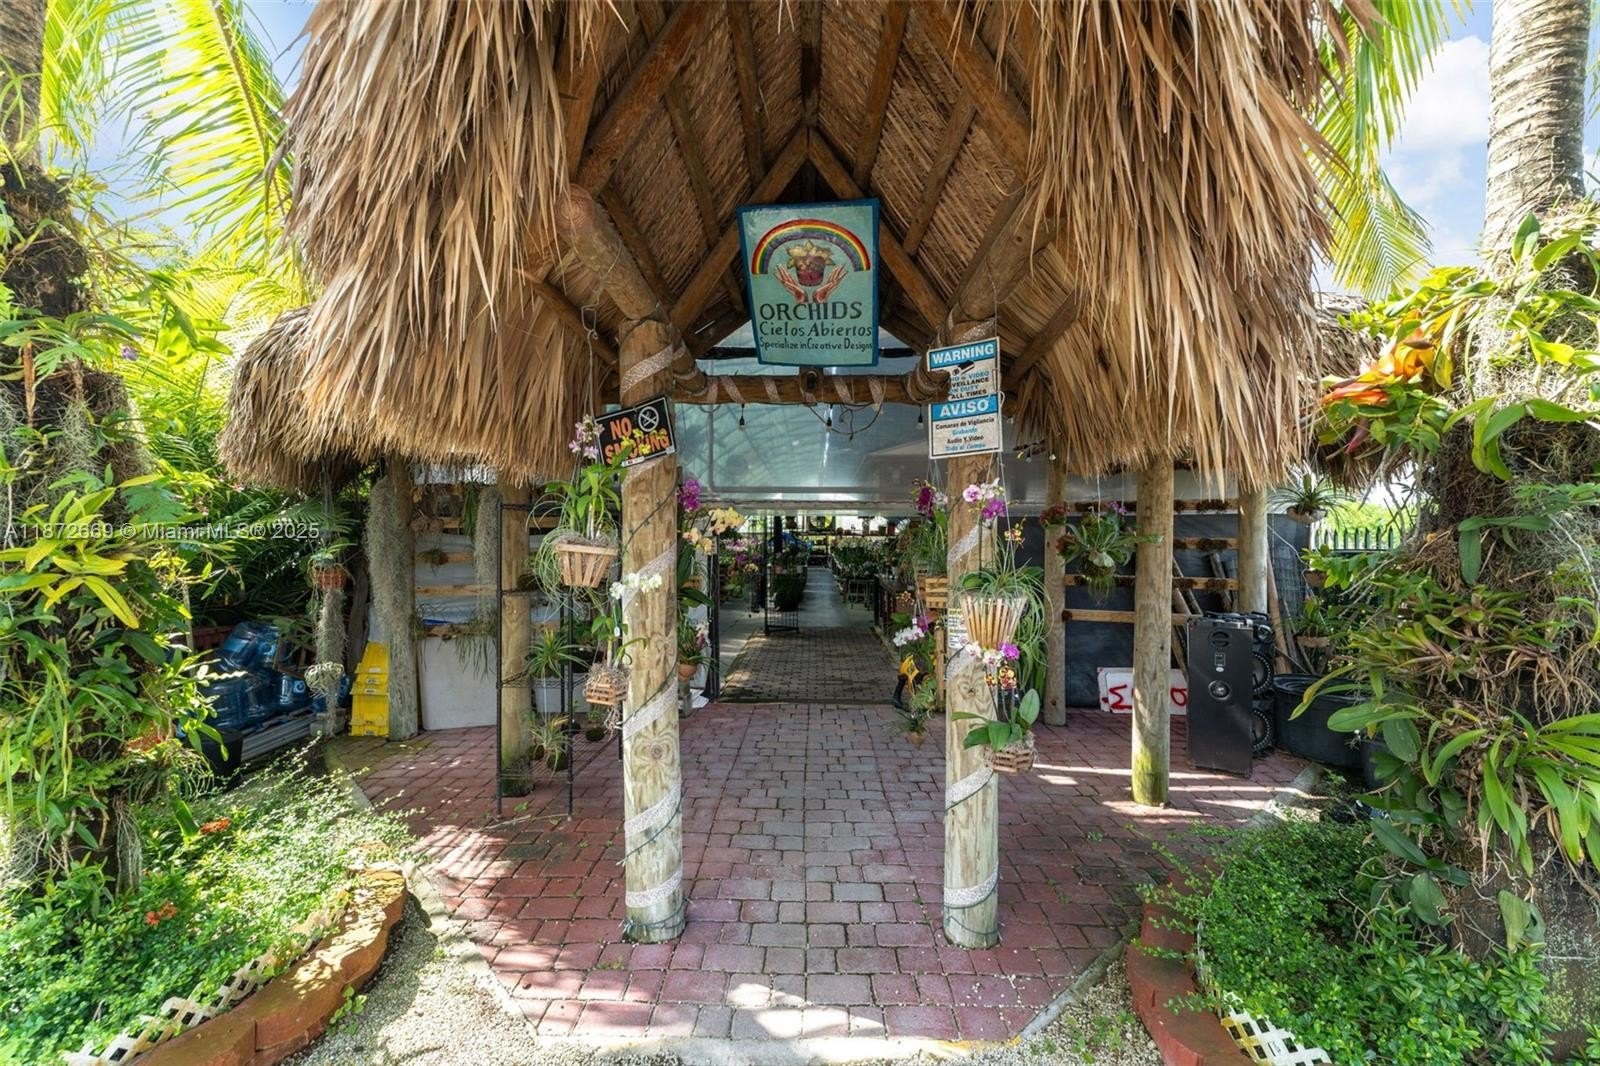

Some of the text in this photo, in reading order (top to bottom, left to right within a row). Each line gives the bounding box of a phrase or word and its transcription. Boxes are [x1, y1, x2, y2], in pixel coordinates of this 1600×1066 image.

[760, 301, 862, 320] ORCHIDS
[760, 321, 873, 337] Cielos Abiertos
[760, 337, 798, 351] Specialize
[807, 338, 840, 350] Creative
[844, 337, 873, 352] Designs
[932, 343, 995, 364] WARNING
[951, 377, 990, 387] VEILLANCE
[969, 370, 990, 379] VIDEO
[951, 388, 987, 400] ALL TIMES
[960, 384, 979, 392] DUTY
[939, 399, 990, 418] AVISO
[609, 417, 632, 440] NO
[604, 428, 670, 465] SOING
